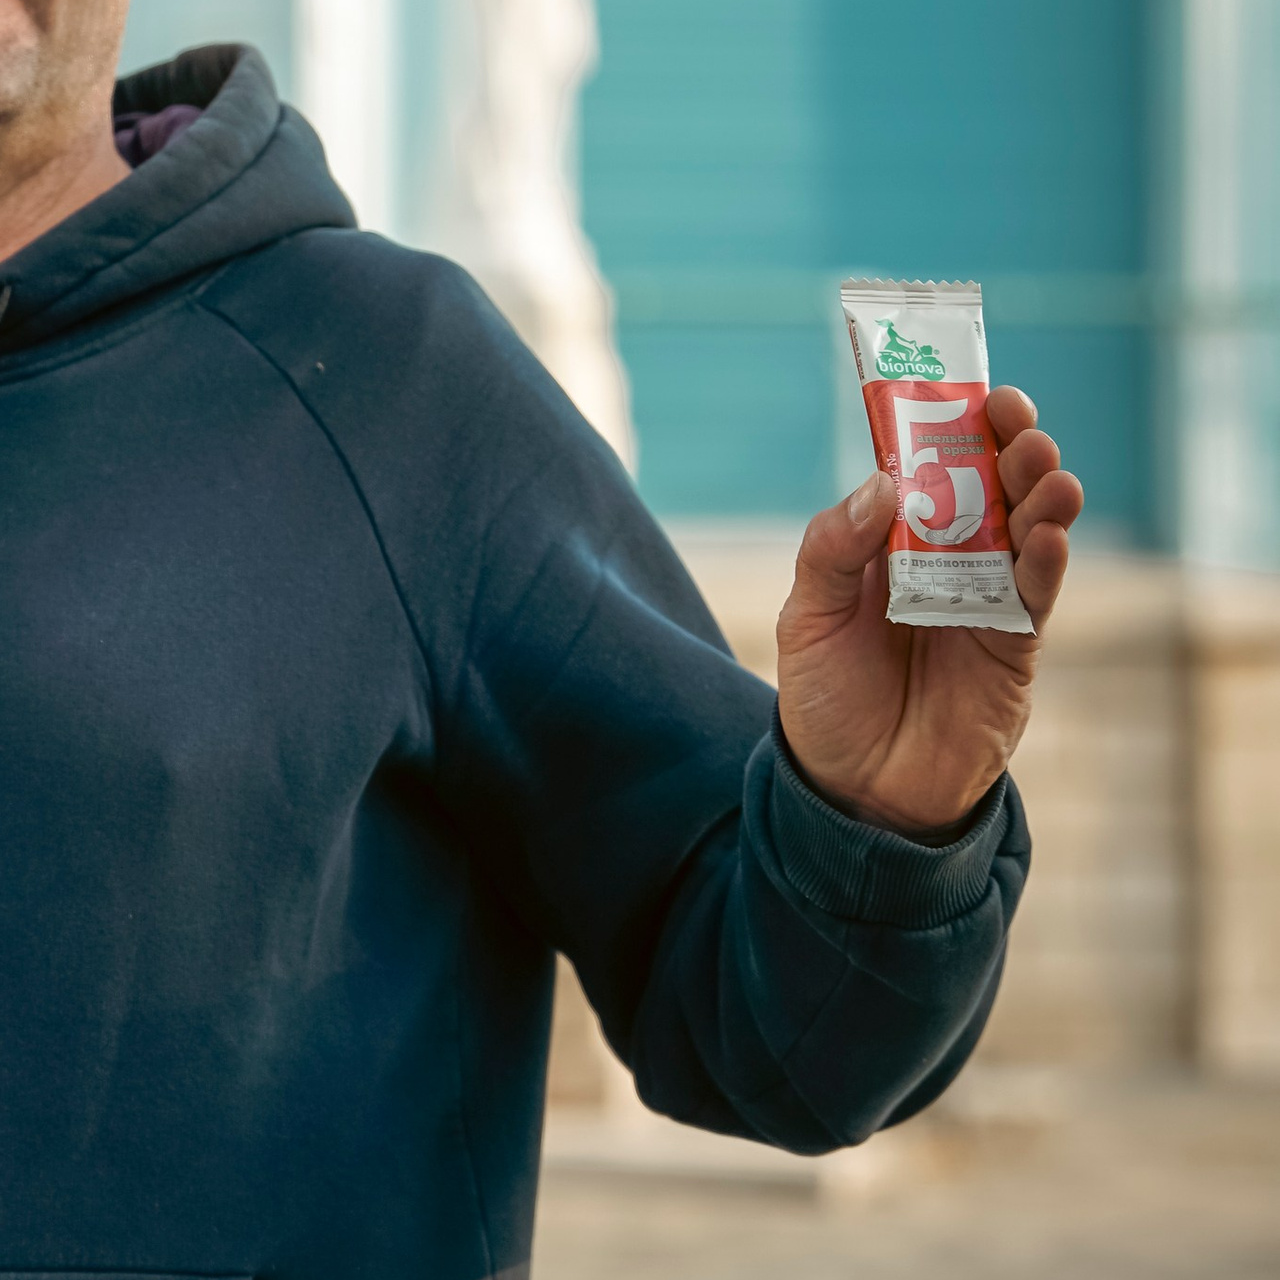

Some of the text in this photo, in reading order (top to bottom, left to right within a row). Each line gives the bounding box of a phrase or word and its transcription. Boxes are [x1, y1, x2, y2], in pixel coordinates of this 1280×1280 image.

[877, 358, 945, 376] bionova
[917, 434, 984, 444] апельсин
[942, 445, 985, 456] орехи
[893, 396, 986, 546] 5
[900, 558, 1003, 568] с пребиотиком
